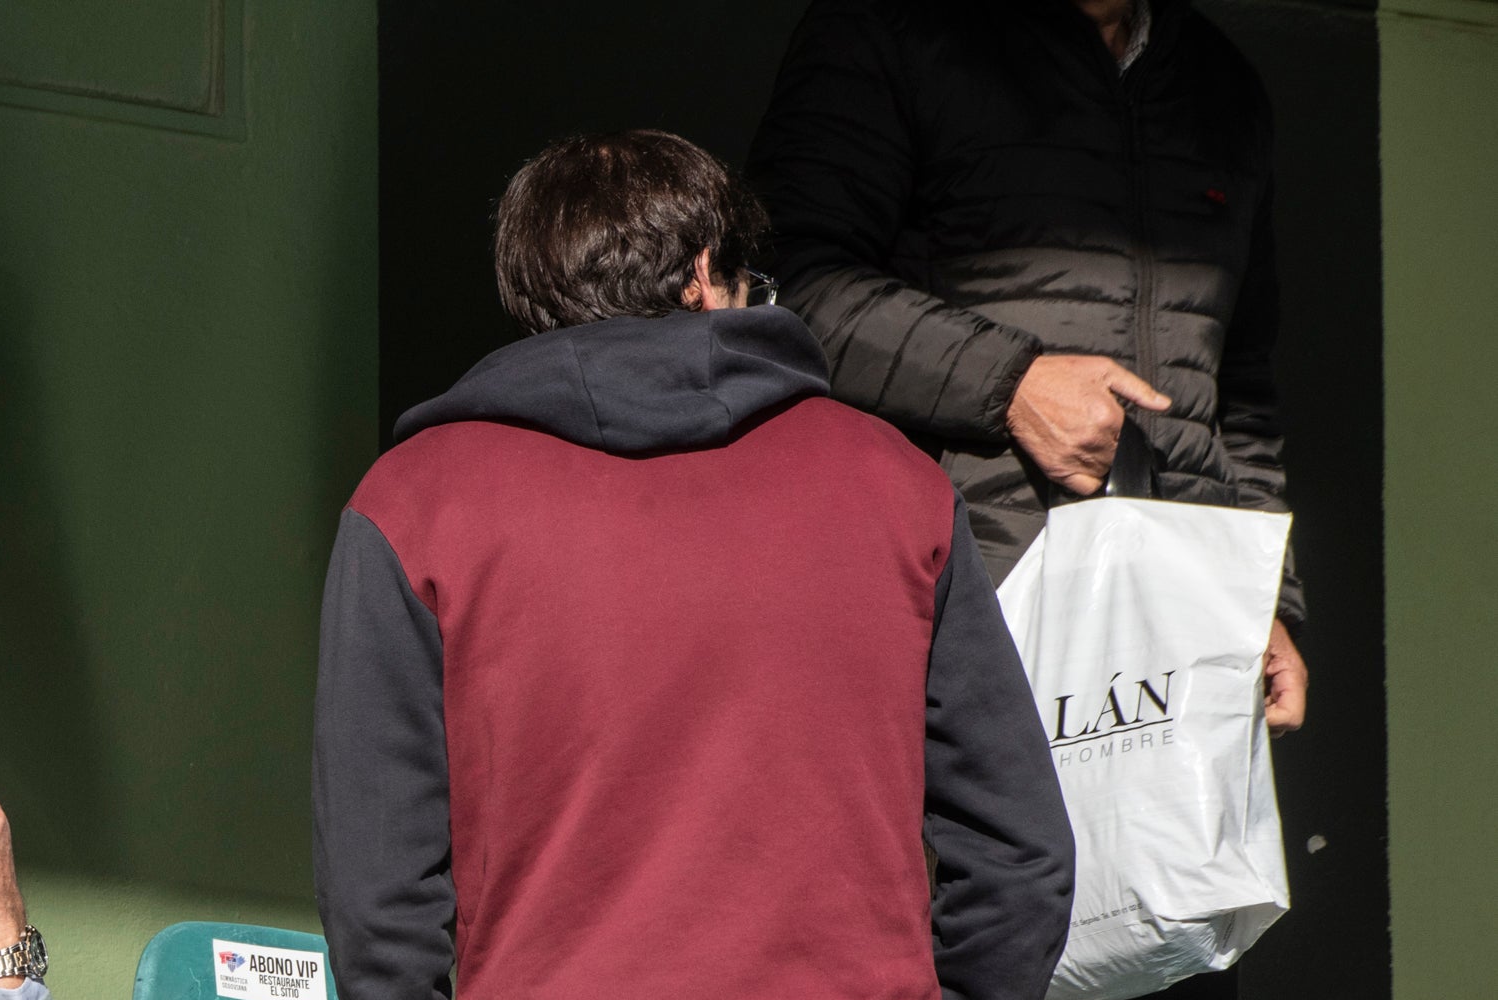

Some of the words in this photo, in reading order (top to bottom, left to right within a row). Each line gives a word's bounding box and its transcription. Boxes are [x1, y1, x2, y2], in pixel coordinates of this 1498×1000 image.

[1049, 670, 1176, 742] LÁN
[1059, 728, 1175, 768] HOMBRE
[249, 954, 293, 976] ABONO
[296, 959, 318, 979] VIP
[259, 974, 310, 989] RESTAURANTE
[270, 987, 279, 996] EL
[280, 987, 300, 998] SITIO
